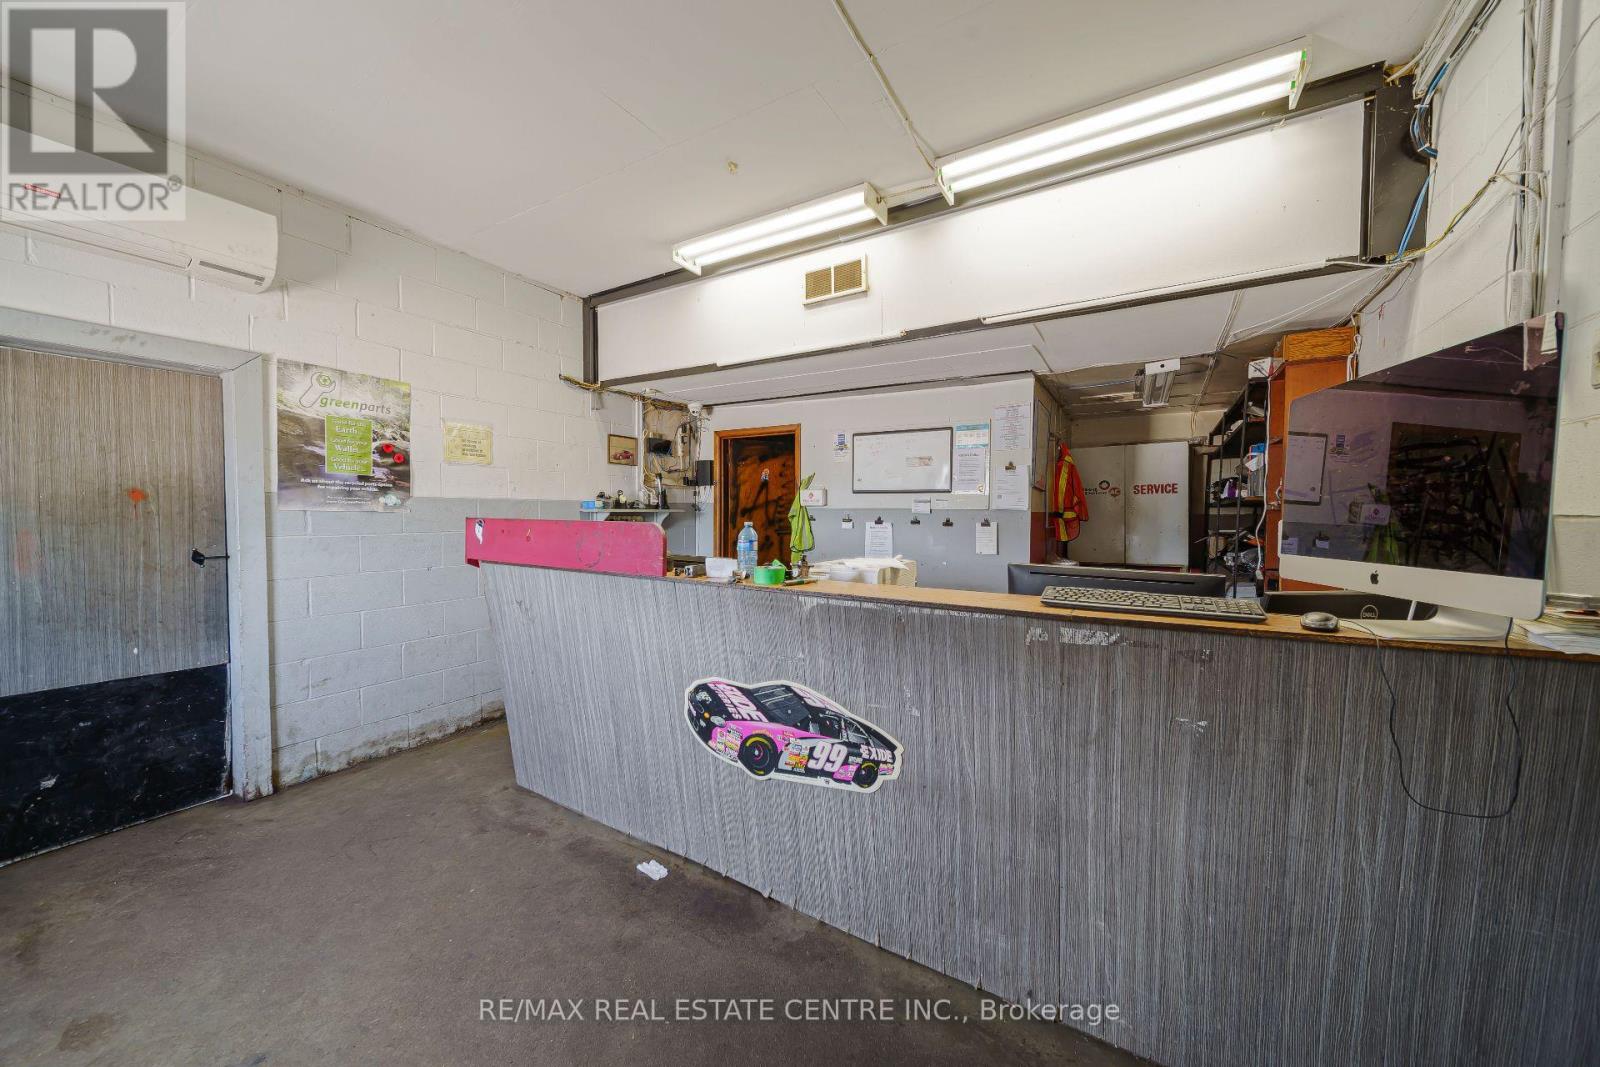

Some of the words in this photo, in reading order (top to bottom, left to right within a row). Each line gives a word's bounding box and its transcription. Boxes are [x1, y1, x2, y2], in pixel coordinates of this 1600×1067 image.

[320, 397, 391, 414] greenparts
[1133, 482, 1179, 495] SERVICE
[808, 741, 848, 773] 99
[860, 744, 893, 763] EXIDE
